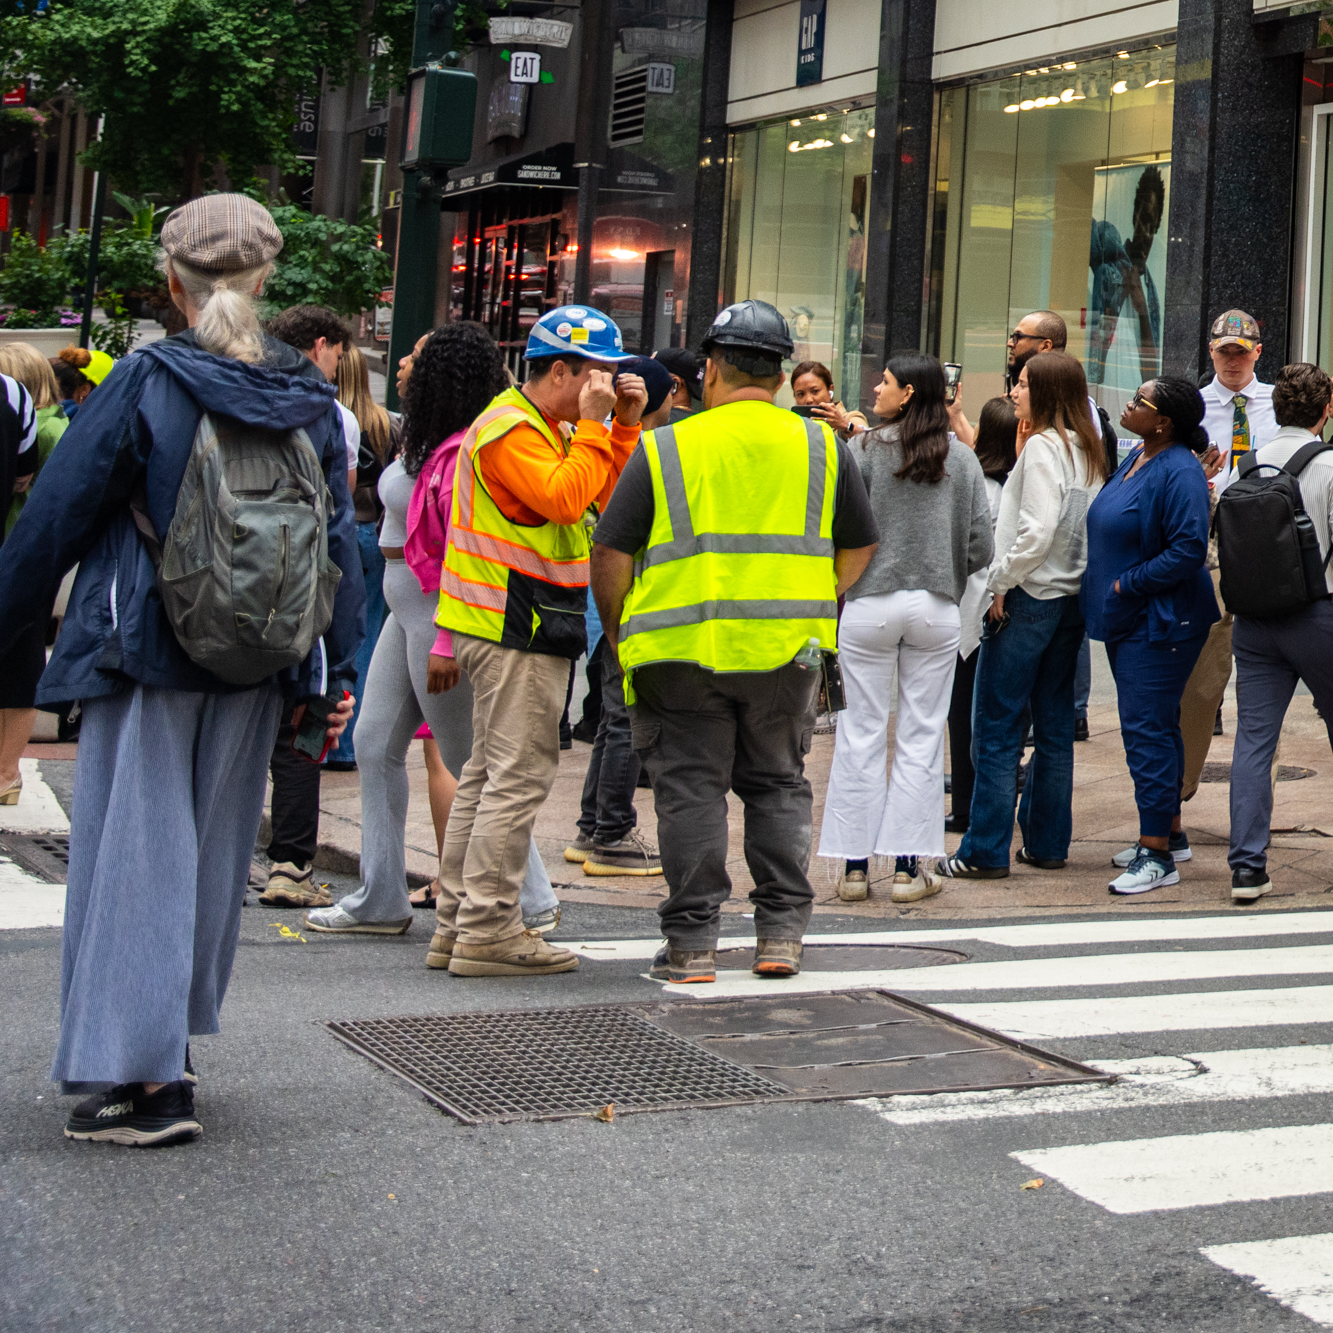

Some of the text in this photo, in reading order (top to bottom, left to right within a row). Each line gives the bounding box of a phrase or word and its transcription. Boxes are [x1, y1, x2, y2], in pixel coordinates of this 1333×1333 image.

[802, 14, 817, 50] GAP
[515, 57, 536, 78] EAT
[801, 53, 814, 64] KIDS
